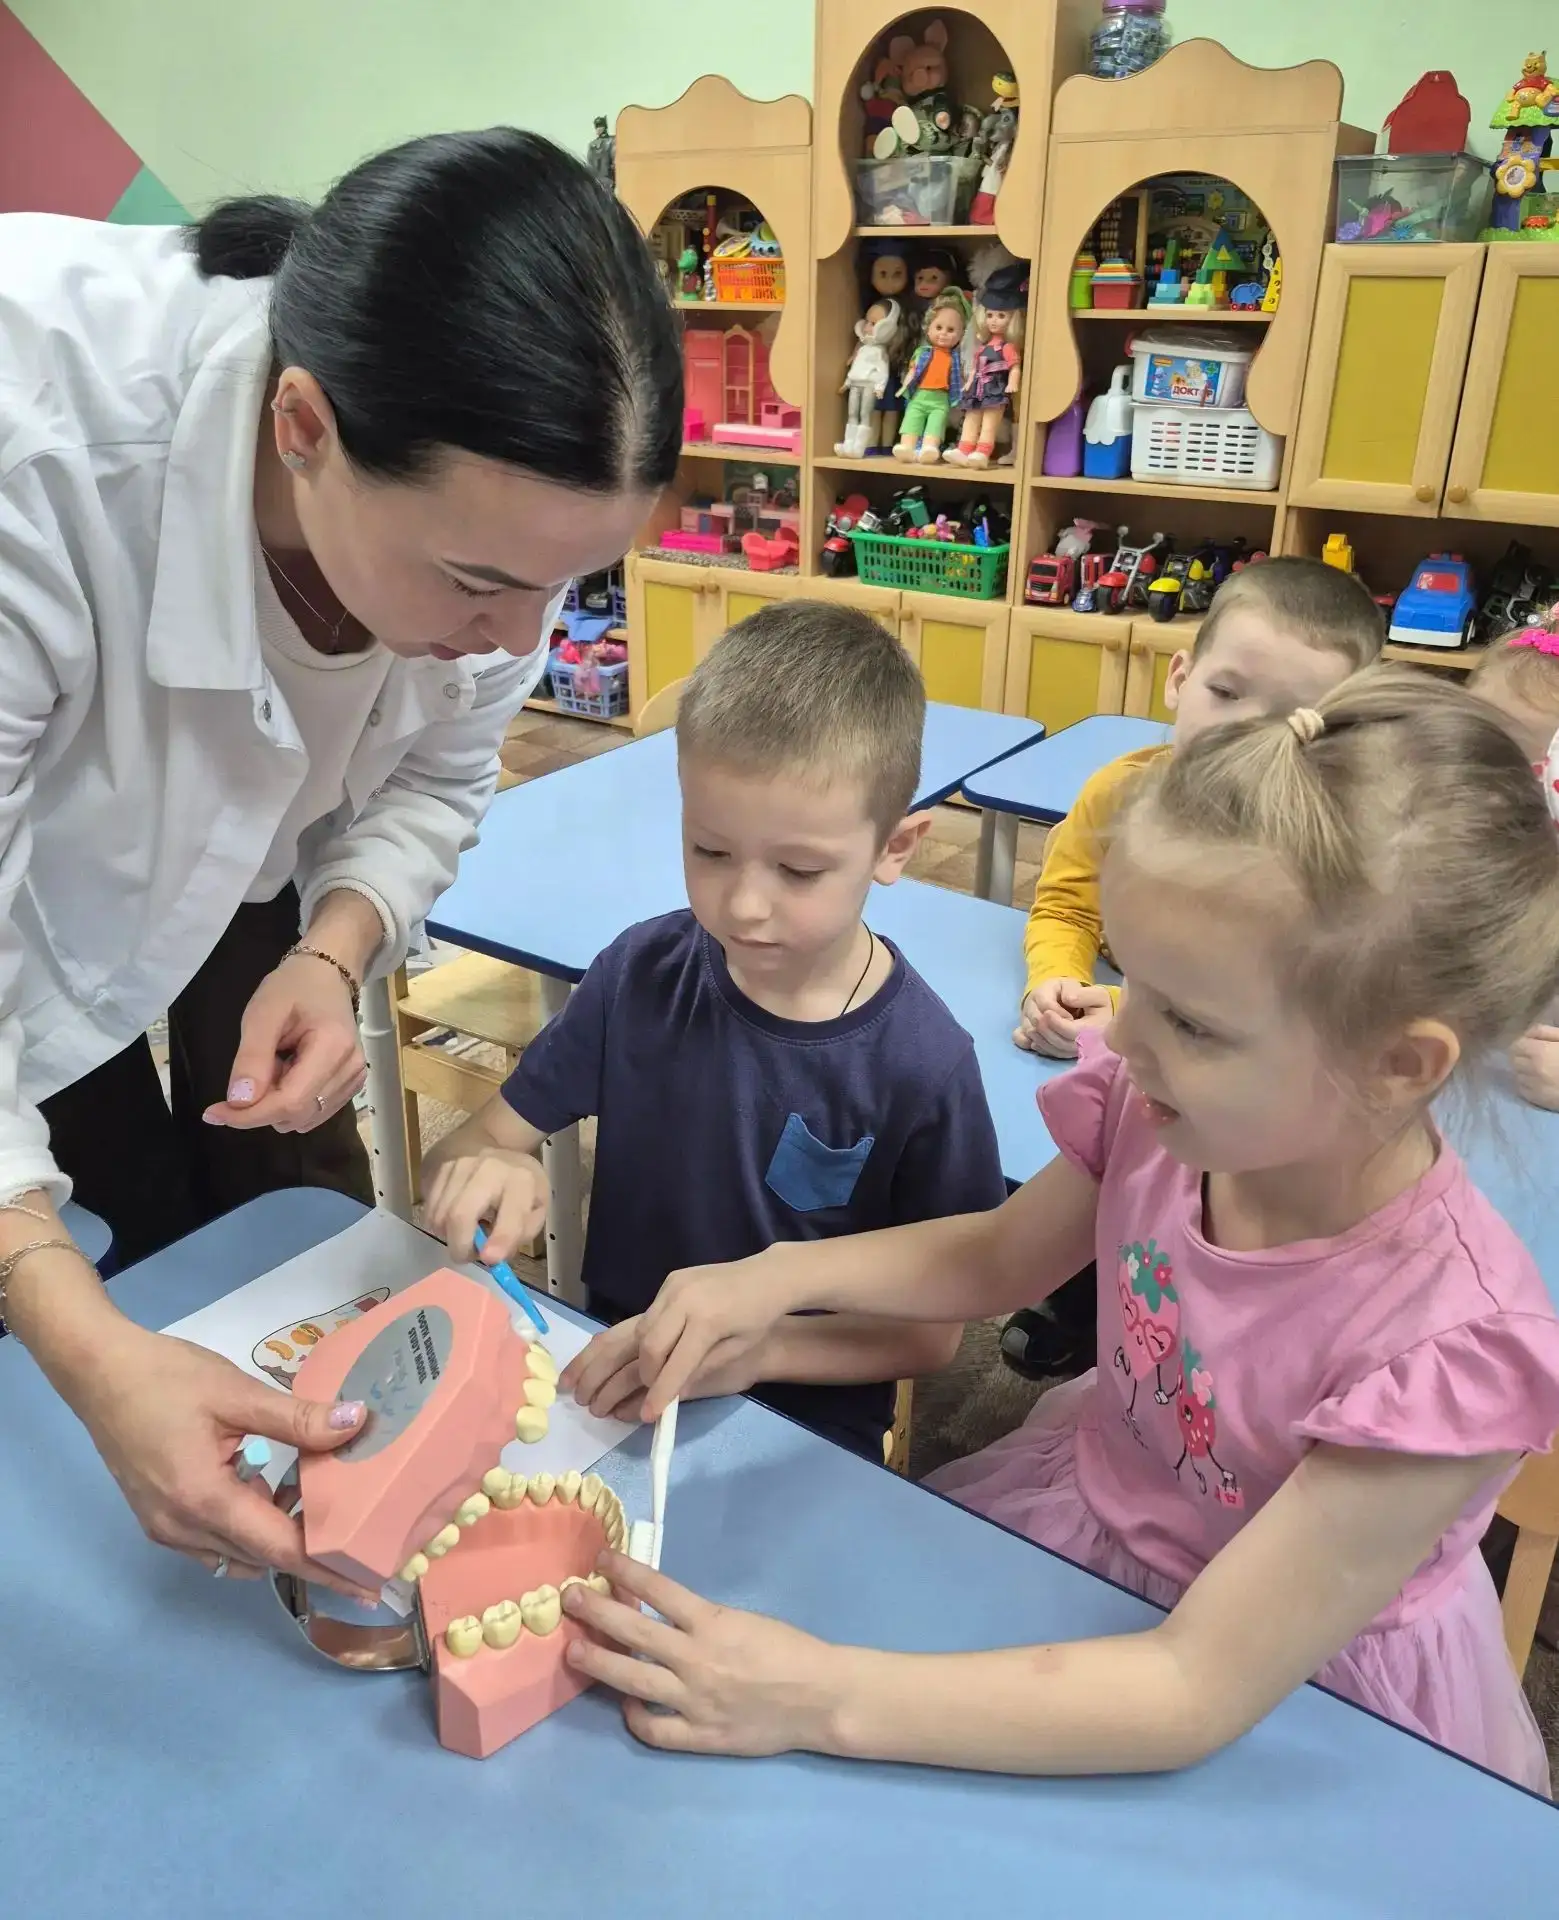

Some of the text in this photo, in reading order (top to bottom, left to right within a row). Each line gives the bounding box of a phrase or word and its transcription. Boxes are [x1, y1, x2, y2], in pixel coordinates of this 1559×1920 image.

[1173, 386, 1213, 398] ДОКТР
[408, 1327, 427, 1384] STUDY MODEL
[417, 1309, 440, 1380] TOOTH BRUSHING
